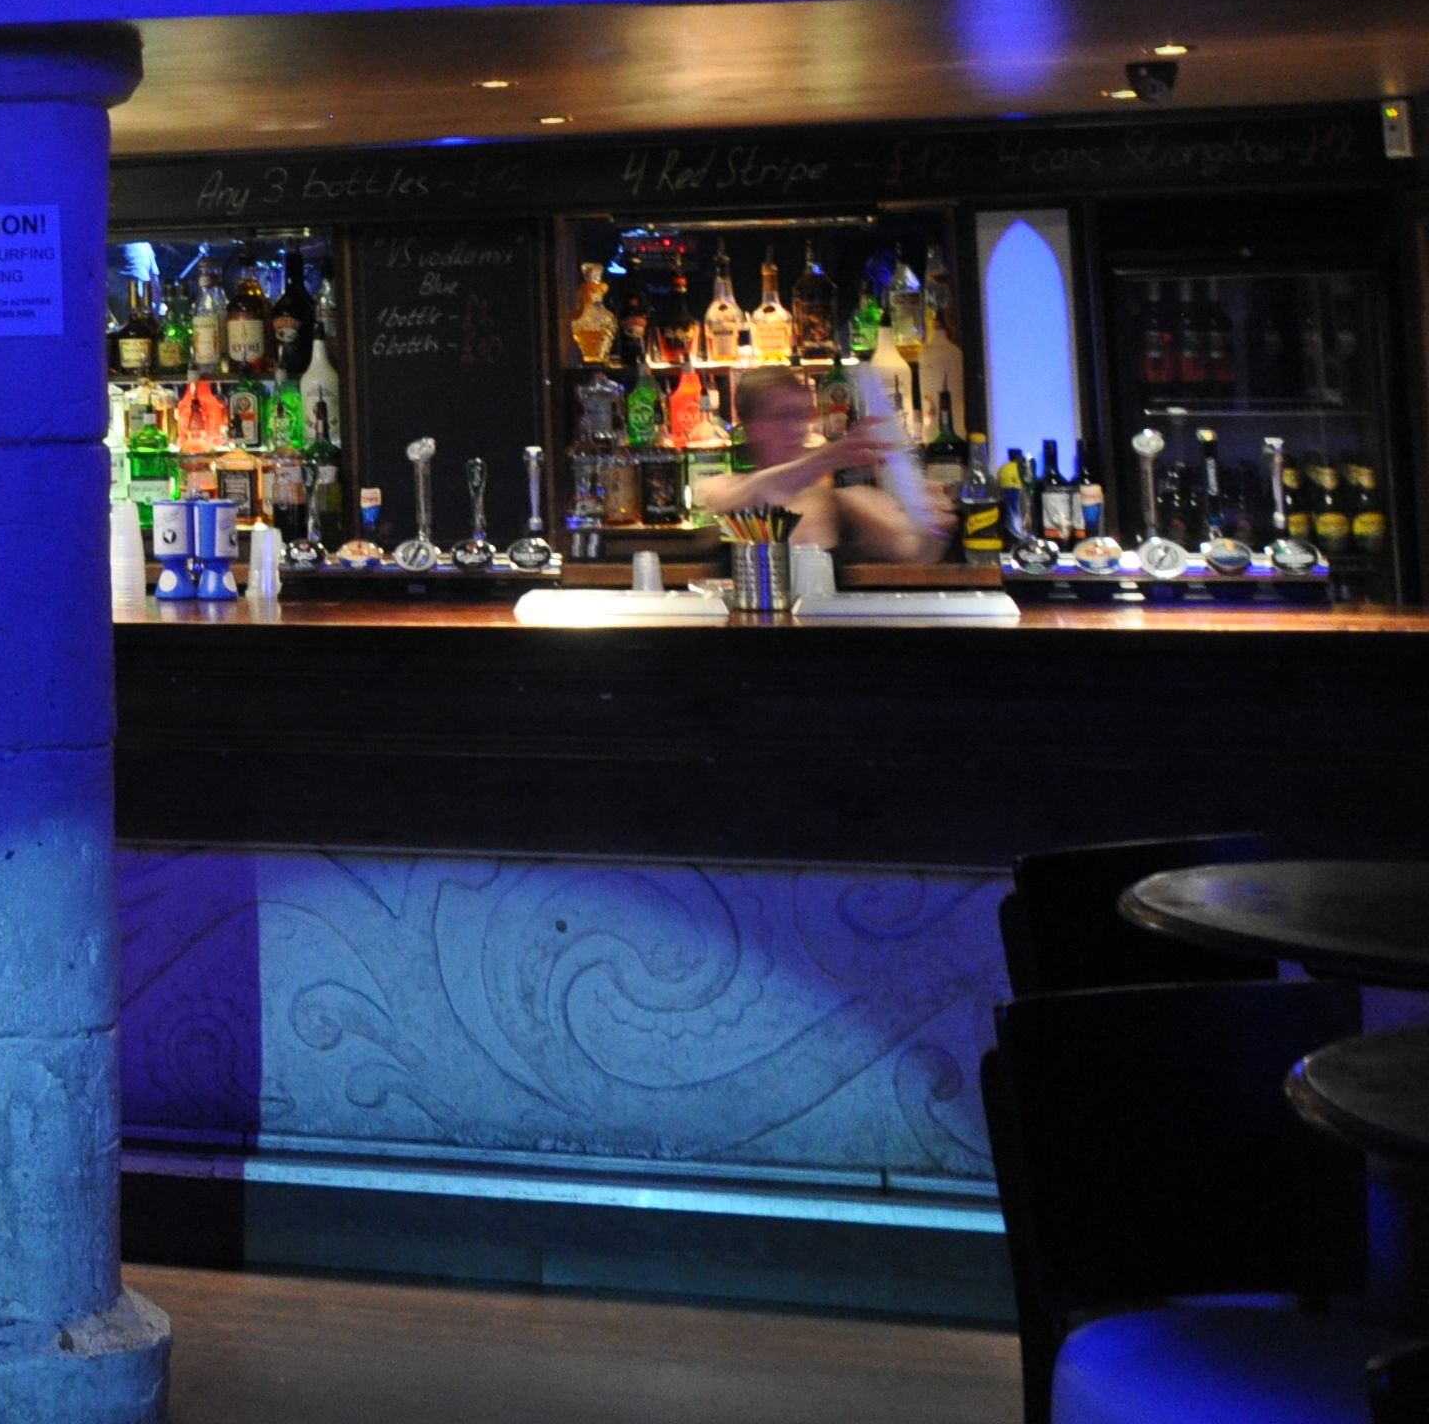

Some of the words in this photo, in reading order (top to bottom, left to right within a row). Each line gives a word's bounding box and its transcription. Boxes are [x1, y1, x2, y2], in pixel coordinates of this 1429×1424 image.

[623, 150, 649, 196] 4
[656, 146, 718, 195] Red
[715, 143, 830, 195] Stripe
[196, 167, 251, 216] Any
[262, 166, 290, 205] 3
[301, 165, 430, 201] bottles
[418, 240, 477, 269] vodka
[418, 270, 460, 297] Blue
